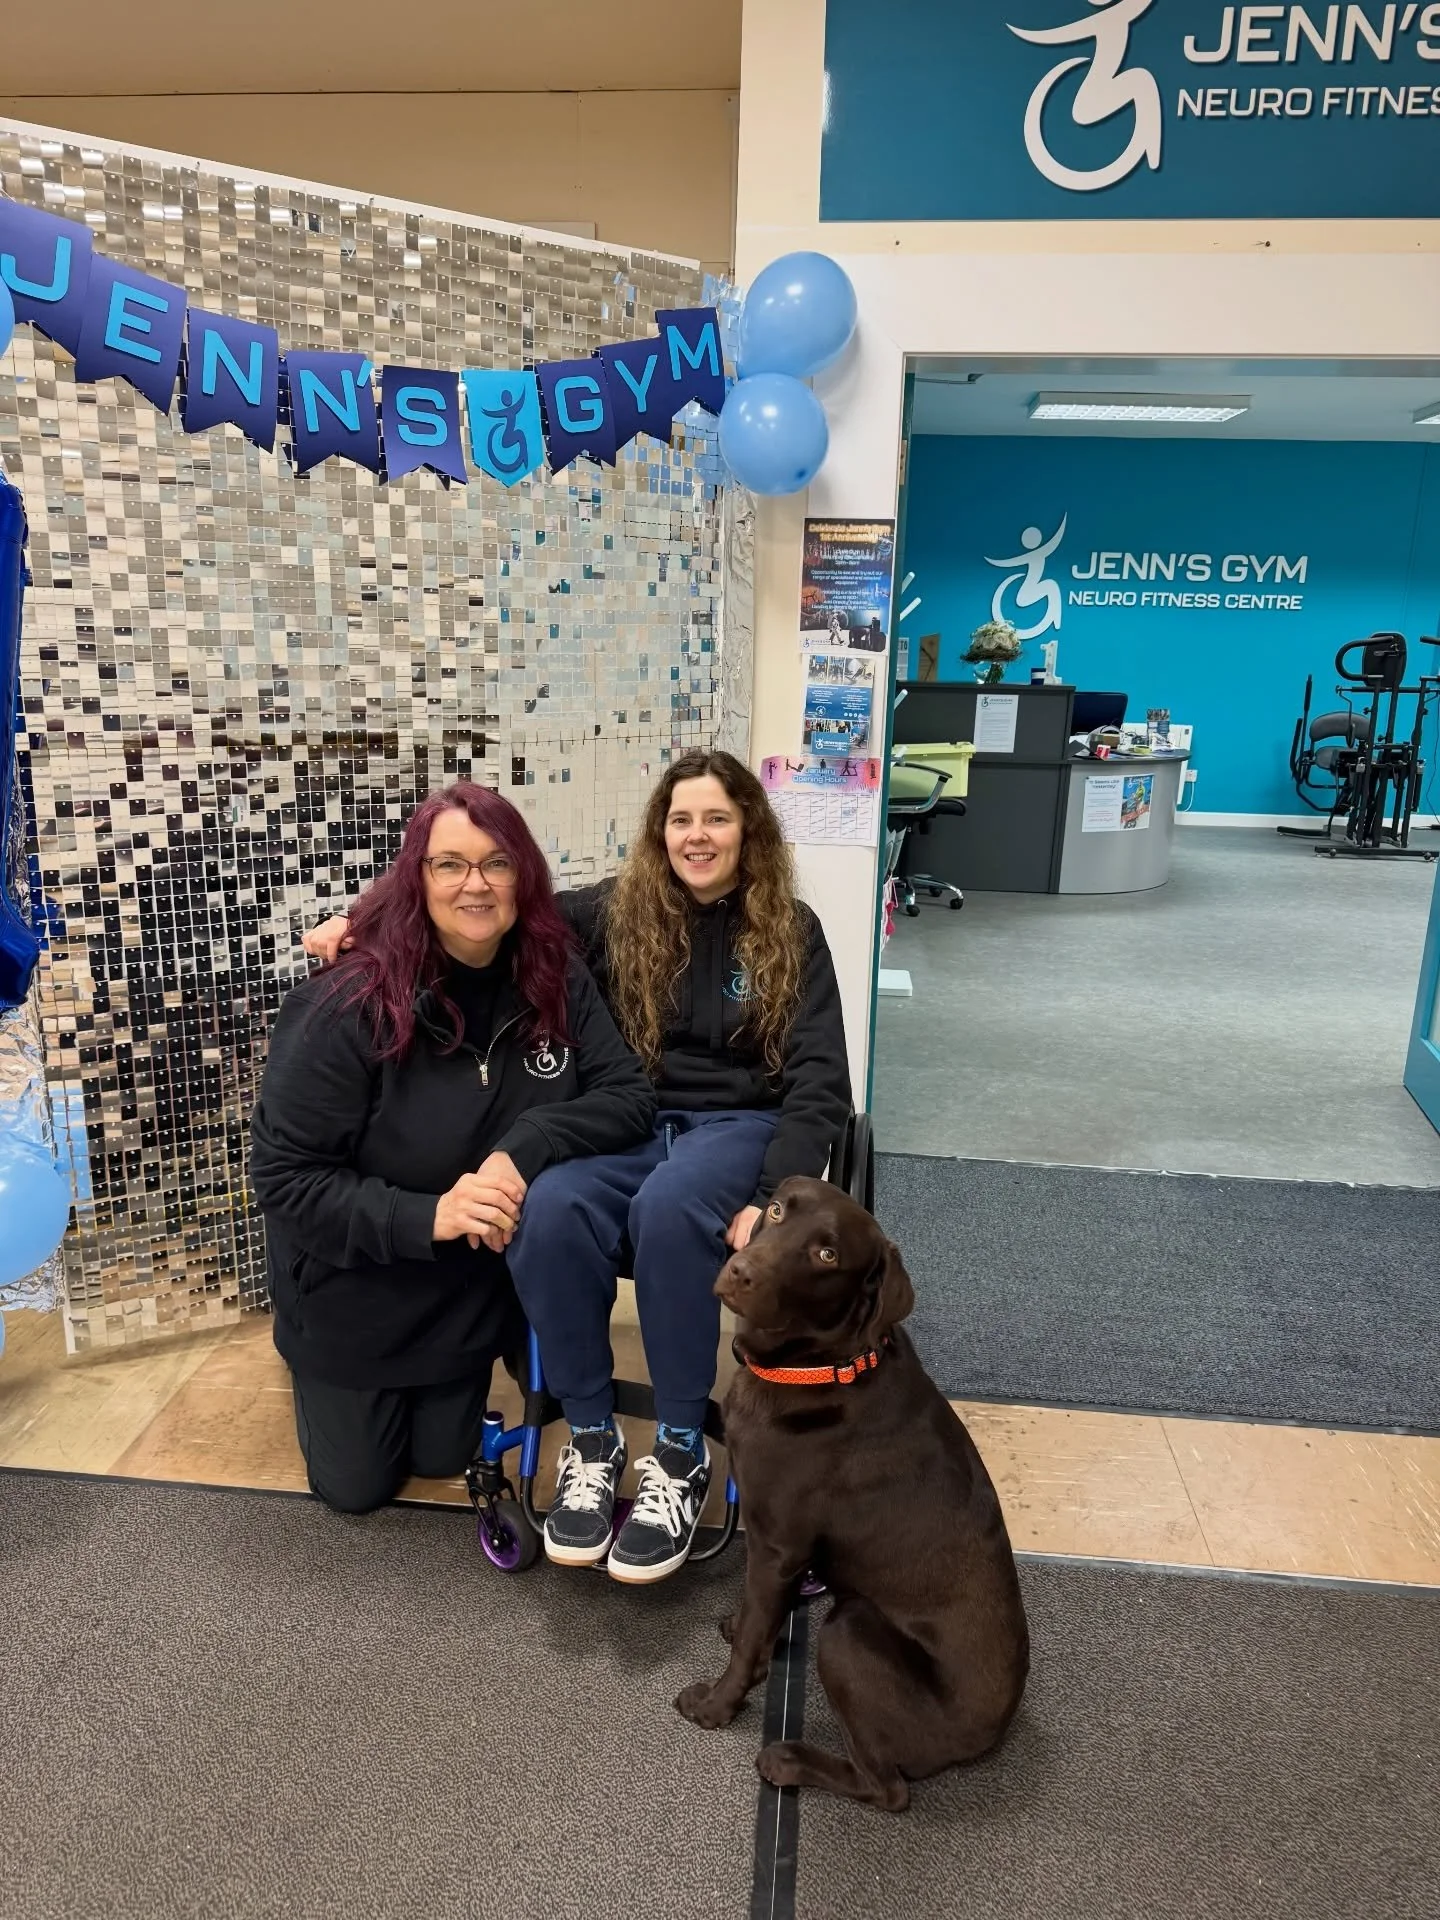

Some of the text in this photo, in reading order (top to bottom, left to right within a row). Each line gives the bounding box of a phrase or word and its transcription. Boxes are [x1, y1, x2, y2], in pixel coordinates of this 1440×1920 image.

[1177, 88, 1312, 117] NEURO
[1, 234, 722, 447] JENN'S GYM
[1071, 551, 1309, 584] JENN'S GYM
[1068, 590, 1303, 610] NEURO FITNESS CENTRE
[793, 775, 823, 784] Opening
[538, 1071, 561, 1080] FITNESS
[559, 1047, 569, 1073] CENTRE
